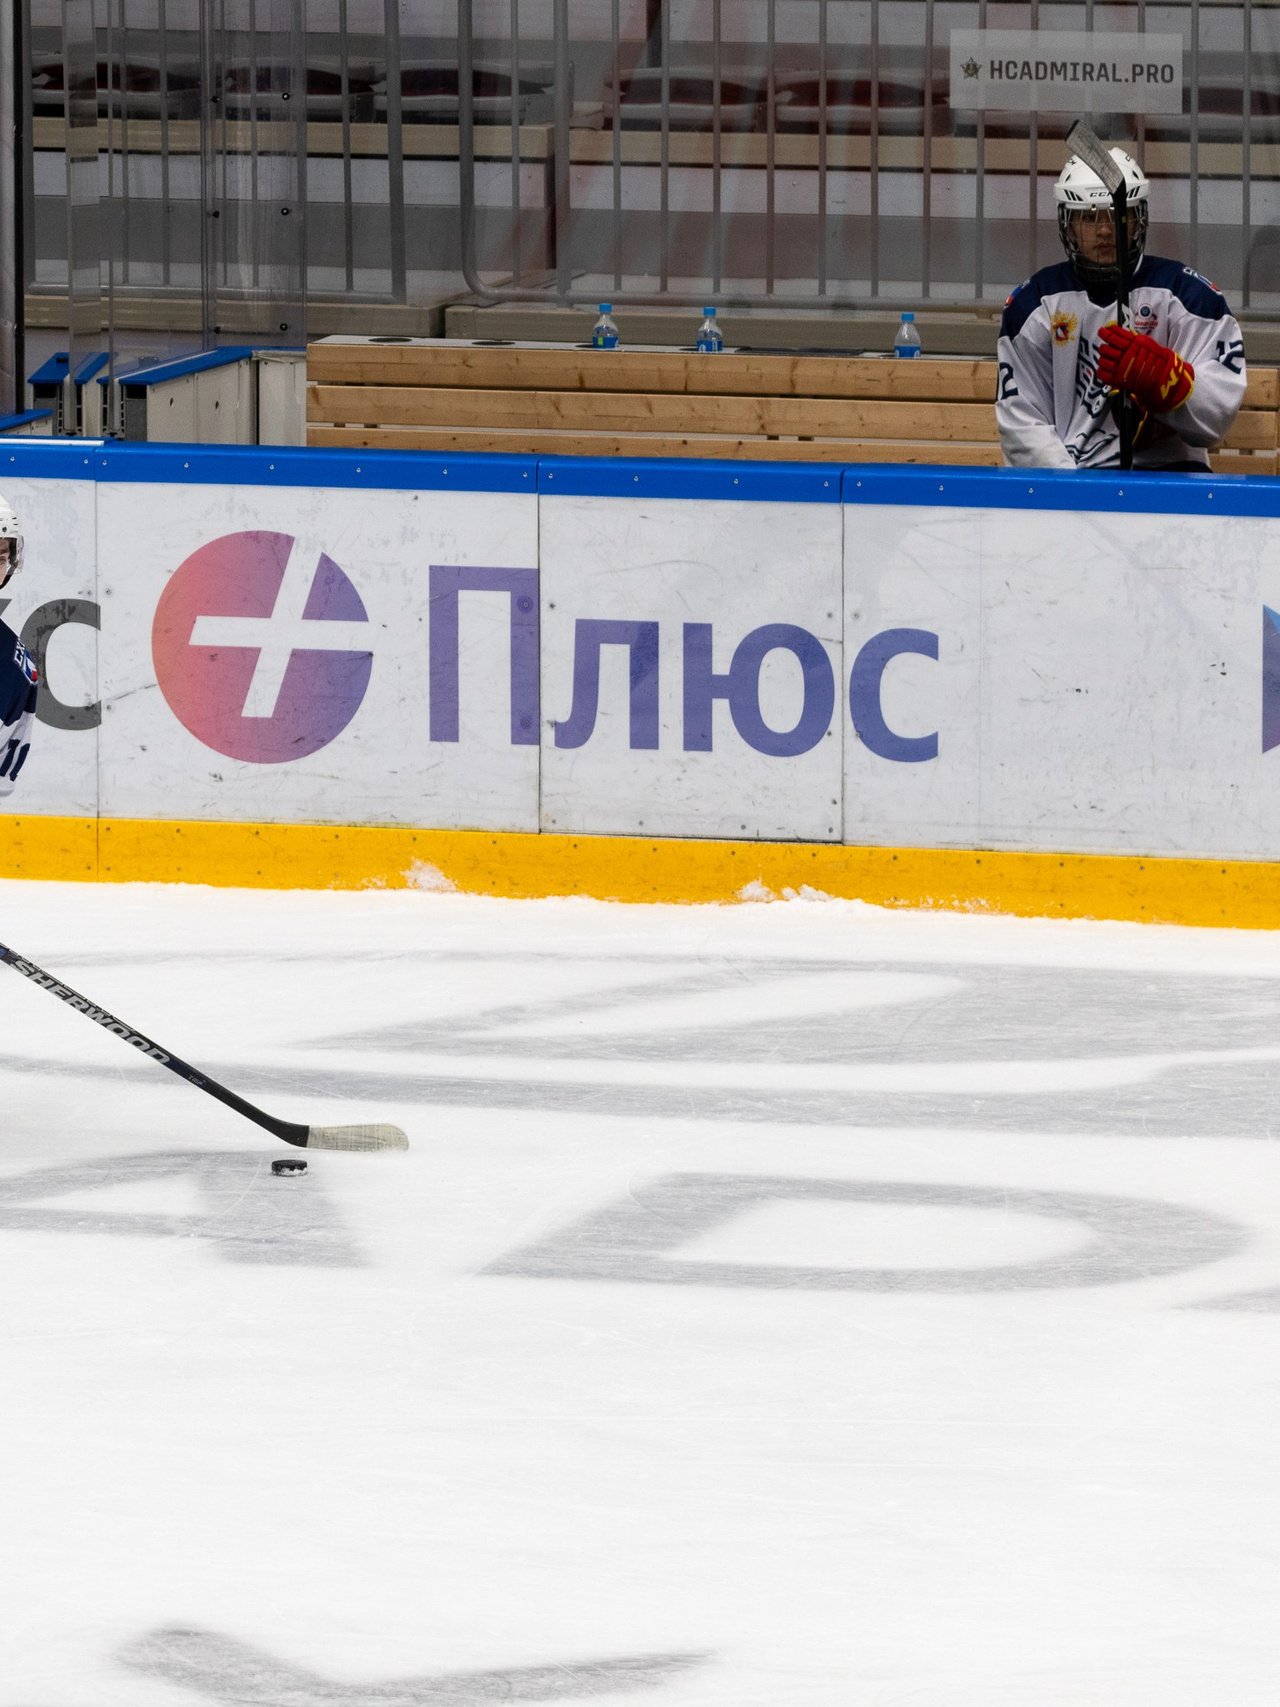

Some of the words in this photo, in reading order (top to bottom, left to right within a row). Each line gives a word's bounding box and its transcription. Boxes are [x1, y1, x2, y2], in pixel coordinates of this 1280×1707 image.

[989, 60, 1174, 83] HCADMIRAL.PRO
[1215, 340, 1246, 375] 12
[999, 362, 1019, 400] 2
[428, 565, 939, 763] Плюс
[10, 960, 170, 1065] SHERWOOD
